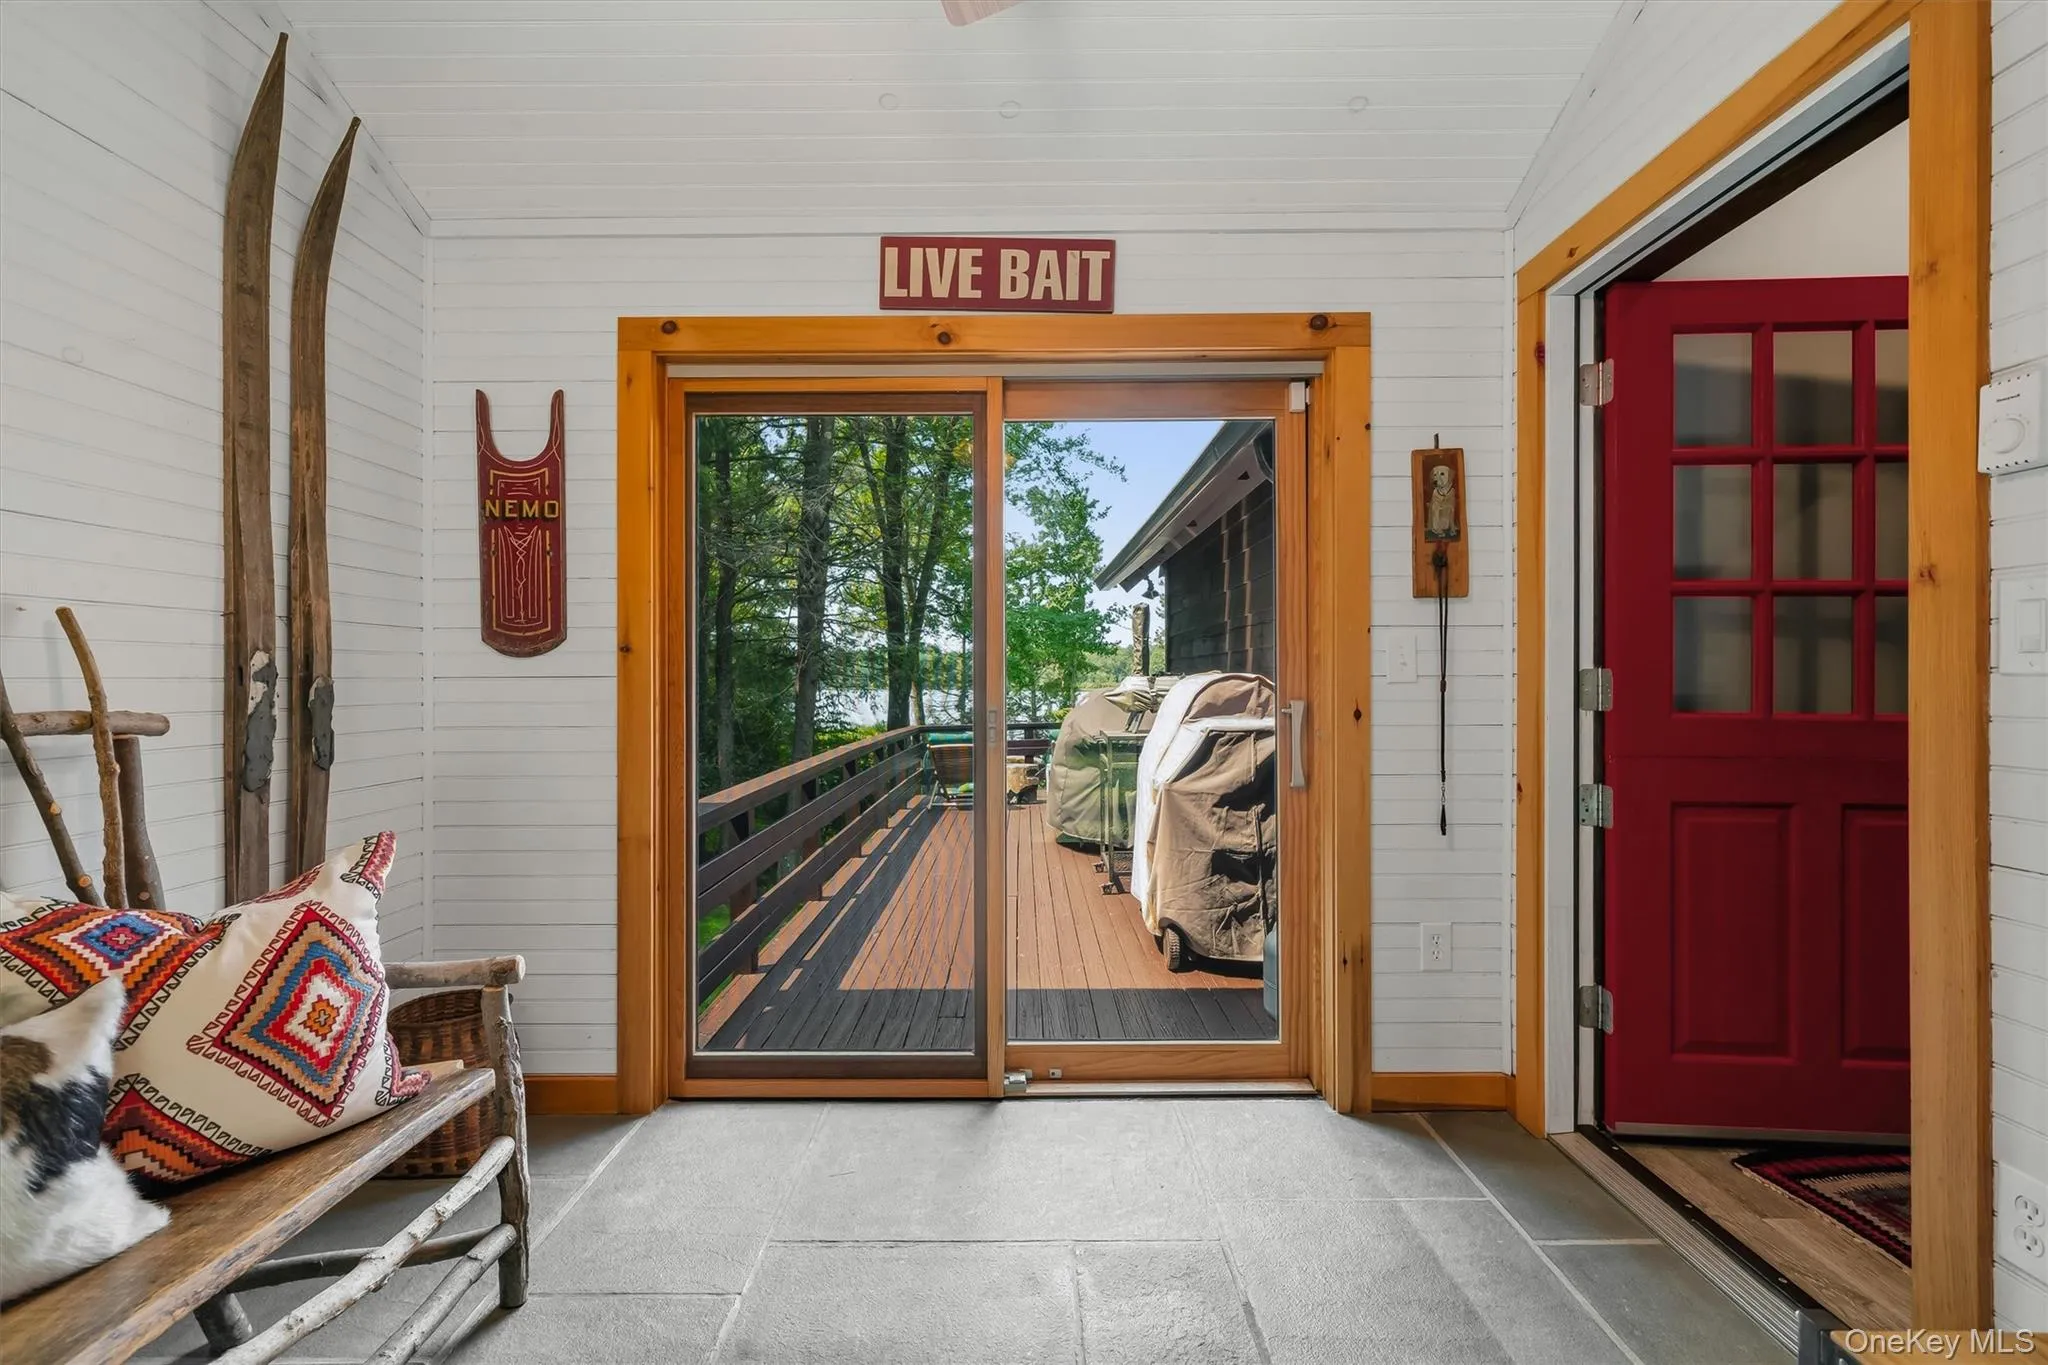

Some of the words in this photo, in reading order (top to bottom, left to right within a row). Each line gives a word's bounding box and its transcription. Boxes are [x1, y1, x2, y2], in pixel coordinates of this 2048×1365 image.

[884, 247, 983, 298] LIVE
[1000, 249, 1111, 301] BAIT
[485, 499, 559, 518] NEMO
